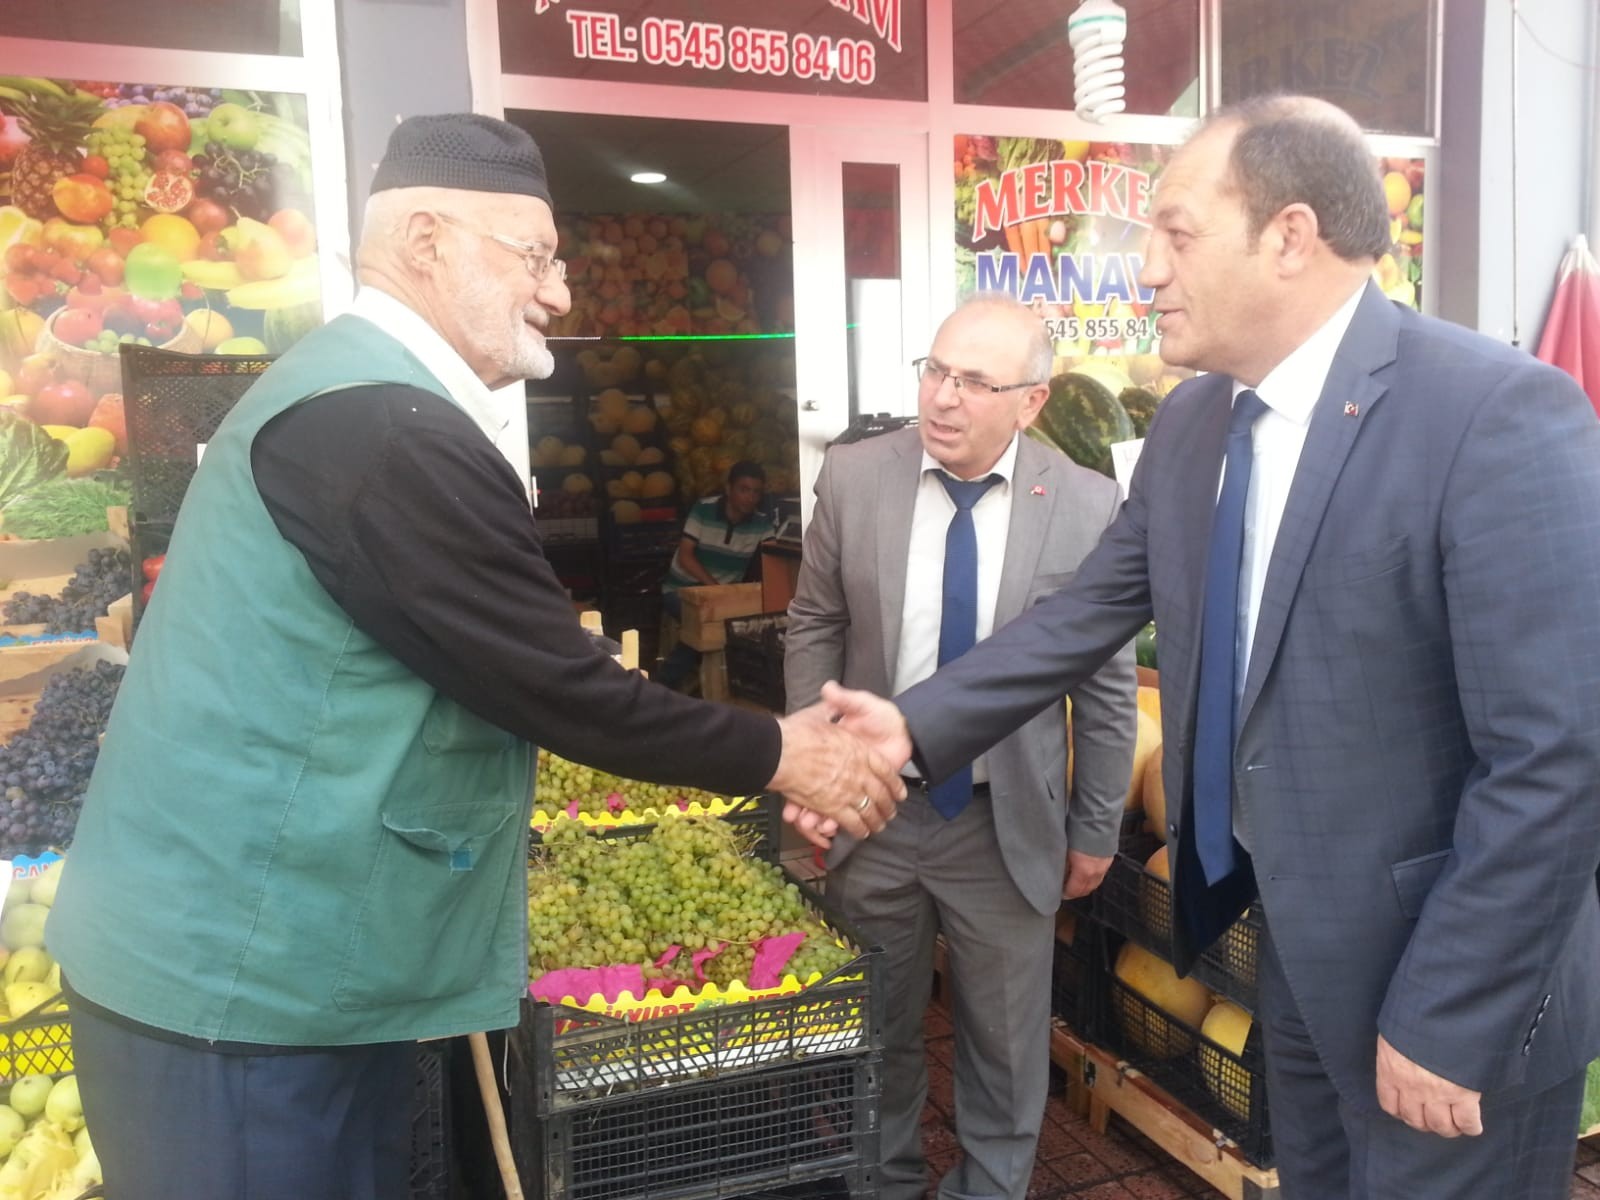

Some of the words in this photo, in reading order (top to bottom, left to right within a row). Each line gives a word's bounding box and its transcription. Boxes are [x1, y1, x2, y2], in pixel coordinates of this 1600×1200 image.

[567, 10, 637, 62] TEL:
[642, 18, 723, 69] 0545
[728, 26, 788, 76] 855
[793, 33, 831, 80] 84
[836, 38, 875, 85] 06
[973, 160, 1158, 242] MERKE
[1085, 317, 1119, 338] 855
[1126, 317, 1149, 338] 84
